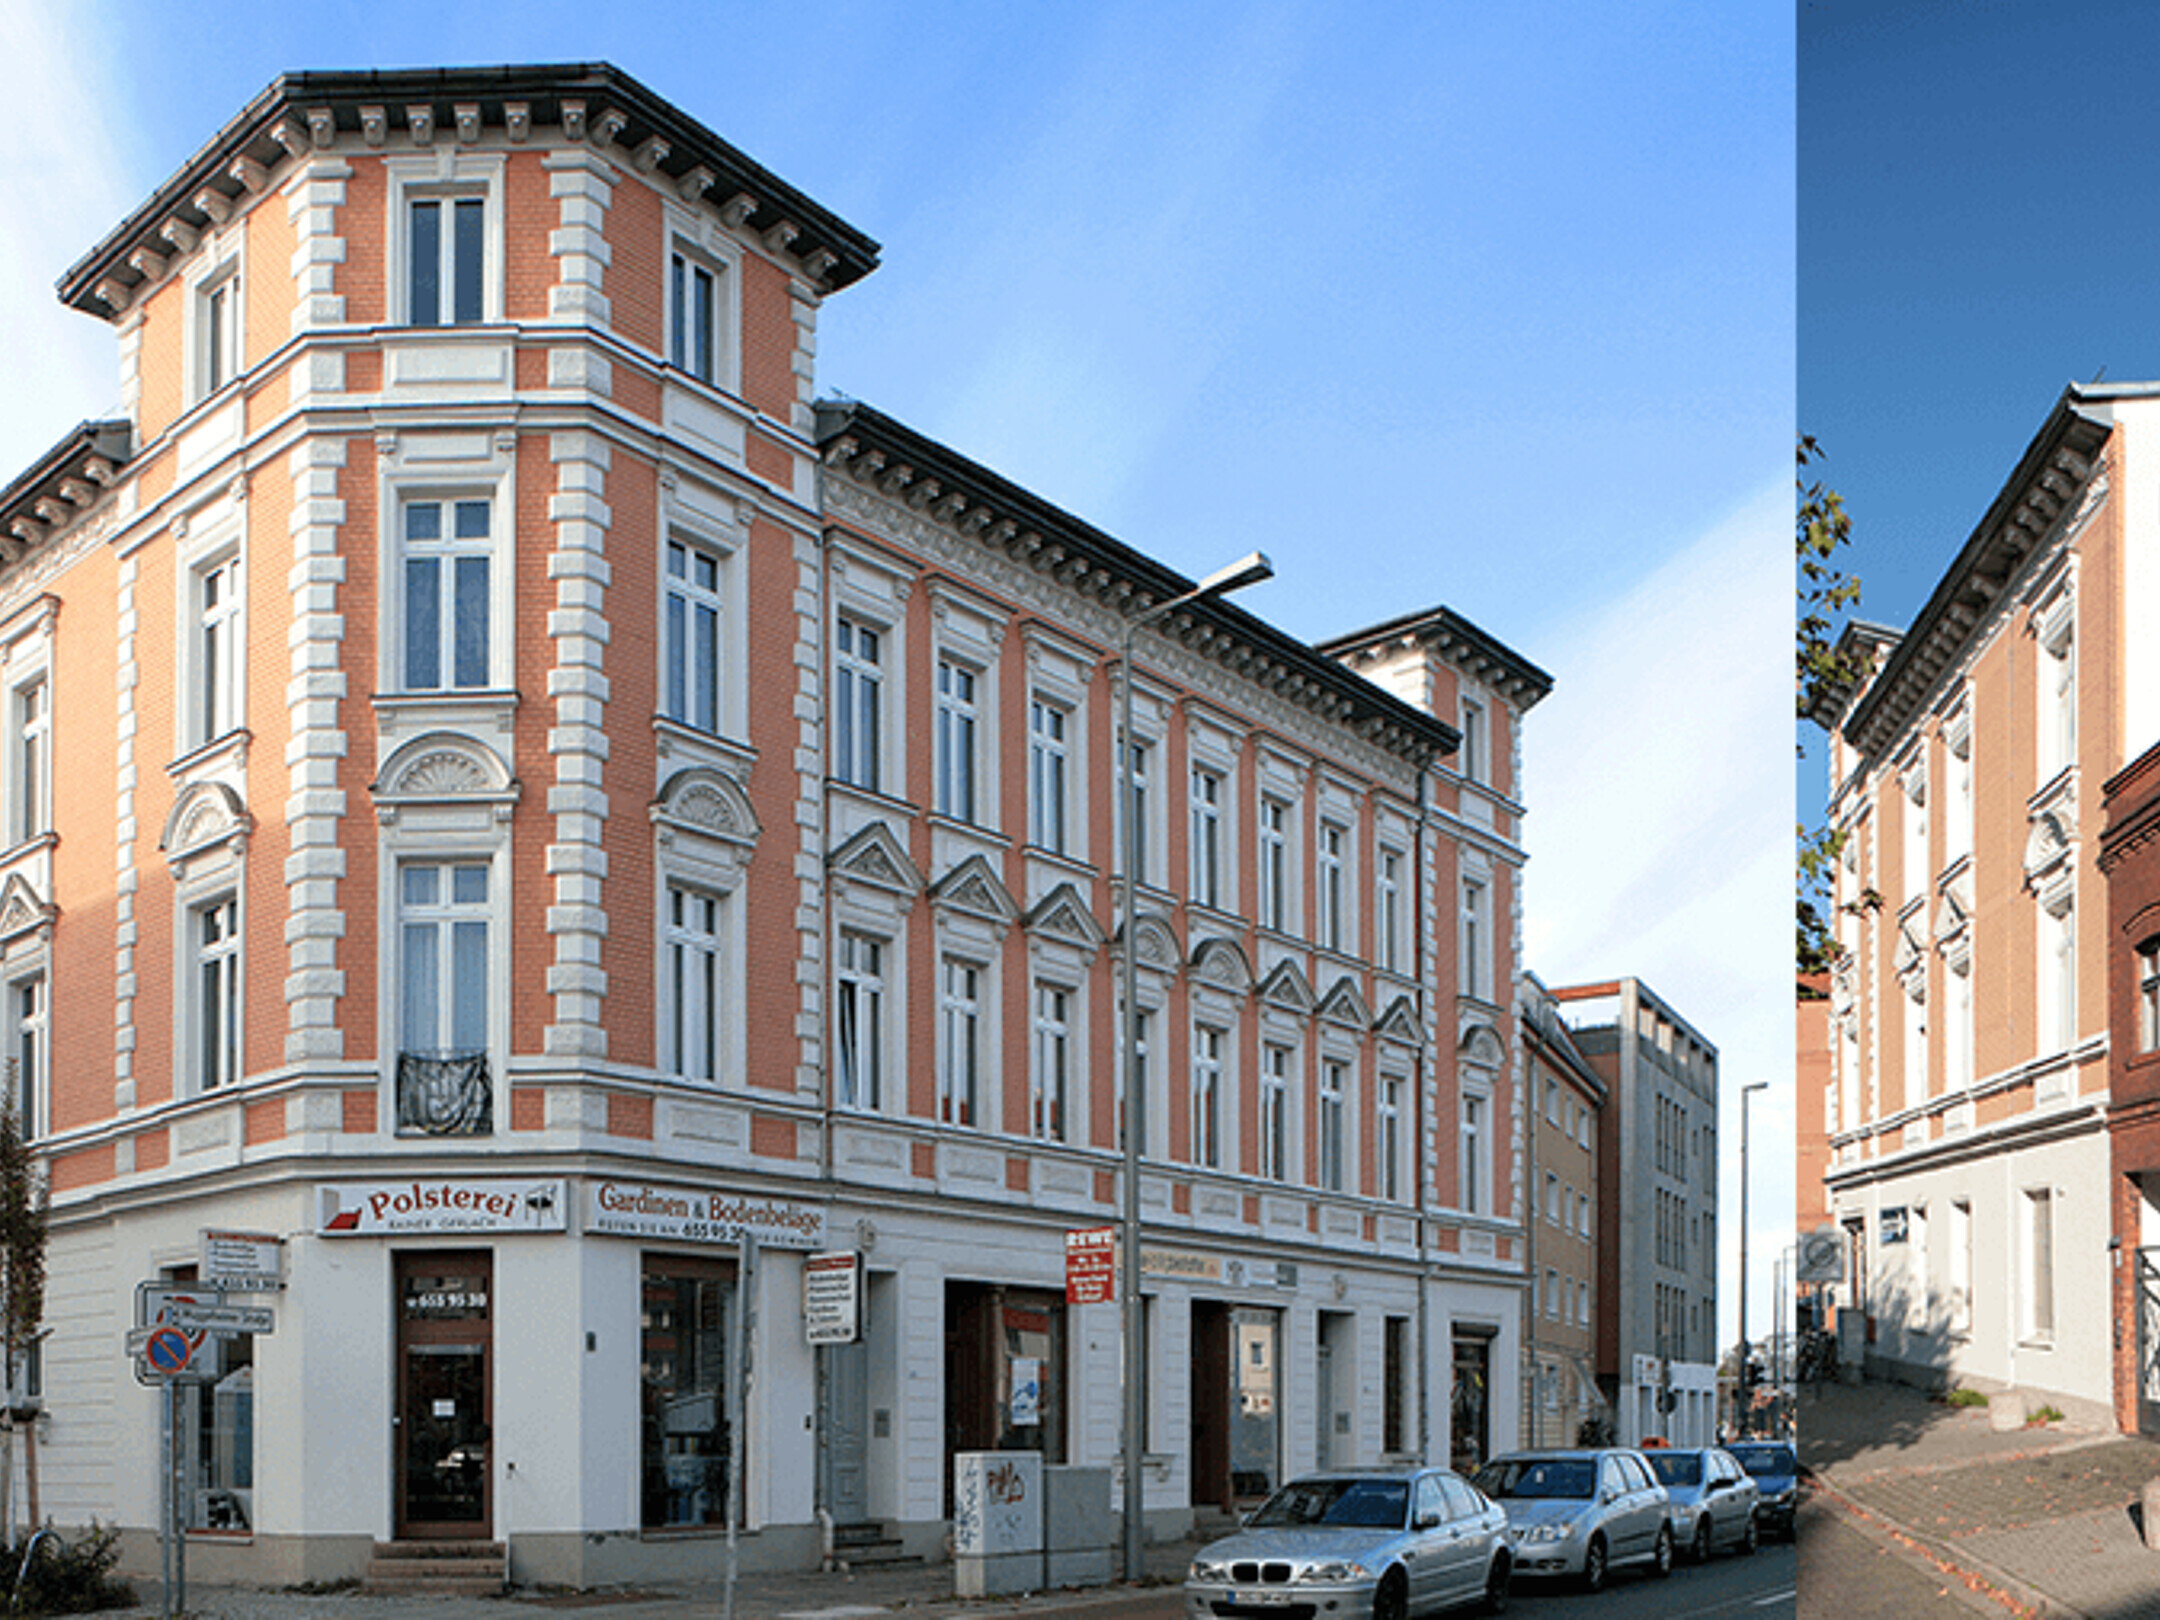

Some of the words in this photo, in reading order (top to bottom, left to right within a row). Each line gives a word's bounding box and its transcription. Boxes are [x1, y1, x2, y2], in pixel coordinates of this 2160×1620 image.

[368, 1183, 517, 1221] Polsterei
[599, 1182, 689, 1218] Gardinen
[419, 1293, 446, 1309] 655
